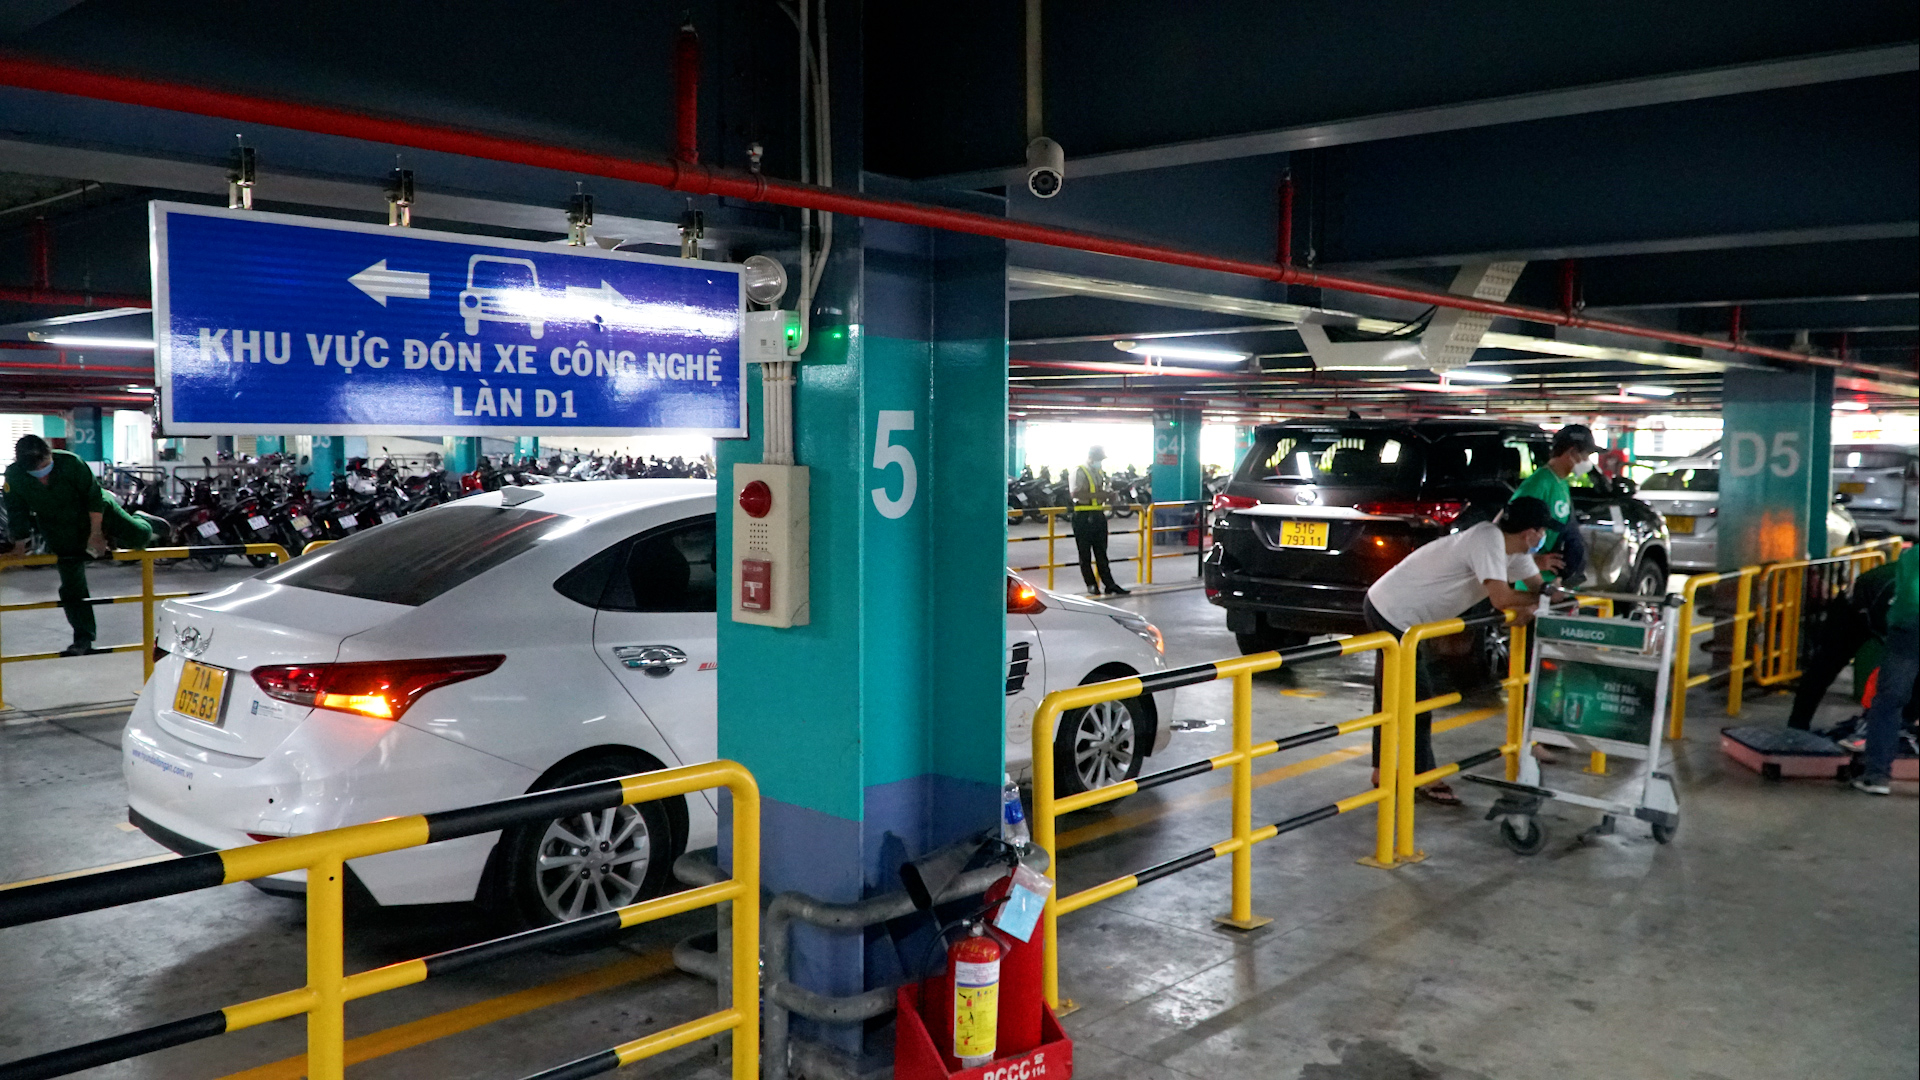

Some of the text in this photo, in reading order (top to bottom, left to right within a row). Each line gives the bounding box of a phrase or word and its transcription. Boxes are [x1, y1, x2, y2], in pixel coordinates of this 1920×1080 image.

[199, 328, 723, 386] KHU VỰC ĐÓN XE CÔNG NGHỆ
[453, 379, 577, 418] LÀN D1
[75, 428, 96, 444] D2
[1155, 434, 1178, 455] C4
[871, 410, 917, 519] 5
[1730, 431, 1799, 477] D5
[1295, 523, 1315, 535] 51G
[192, 667, 211, 691] 71A
[1032, 1064, 1046, 1078] 114
